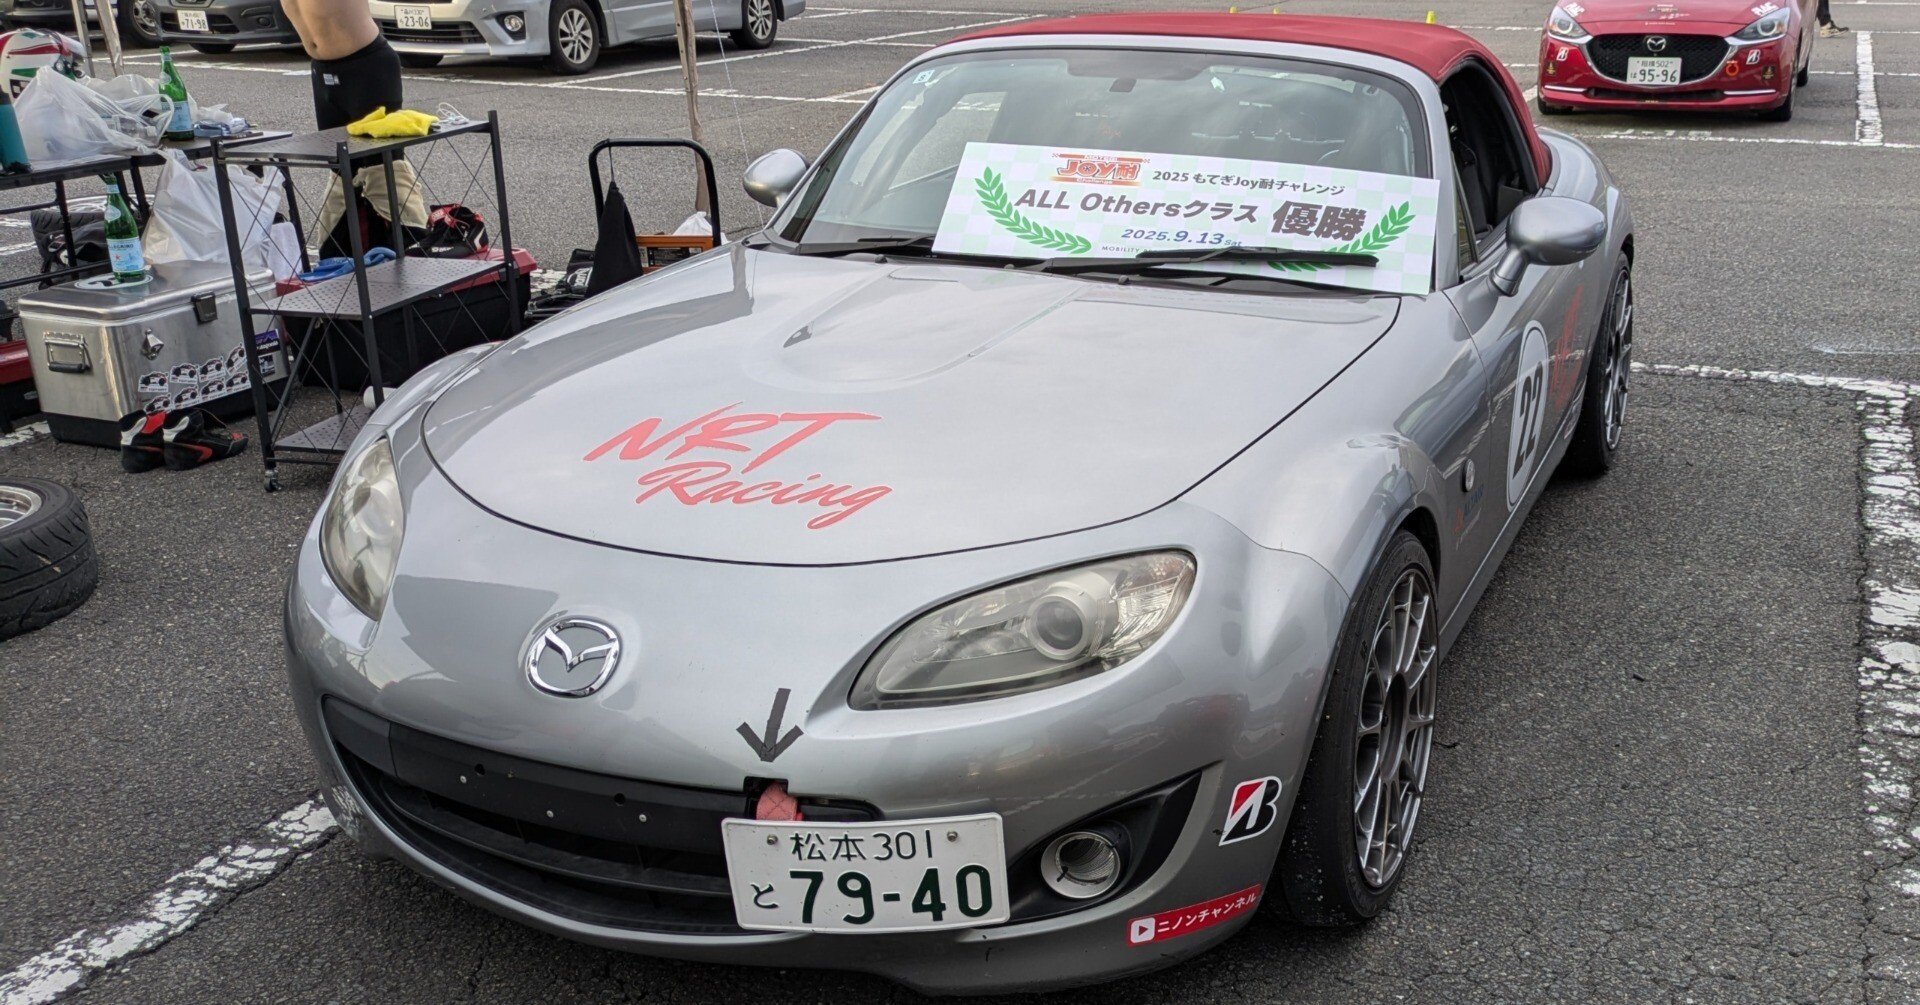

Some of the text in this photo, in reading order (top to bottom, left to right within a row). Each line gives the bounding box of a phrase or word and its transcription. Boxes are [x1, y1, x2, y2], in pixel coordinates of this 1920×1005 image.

[184, 18, 207, 29] 71-98
[404, 16, 430, 28] 23-06
[1638, 69, 1677, 83] 95-96
[1152, 170, 1346, 196] 2025 もてぎJoy耐チャレンジ
[1014, 188, 1368, 241] ALL Othersクラス 優勝
[1101, 245, 1140, 253] MOBILITY
[1121, 228, 1242, 247] 2025.9.13 Sat
[583, 401, 882, 474] NRT
[1512, 361, 1544, 480] 22
[635, 460, 893, 530] Racing
[790, 829, 934, 863] 松本301
[750, 864, 993, 926] と 79-40
[1157, 892, 1258, 933] ニノンチャンネル
